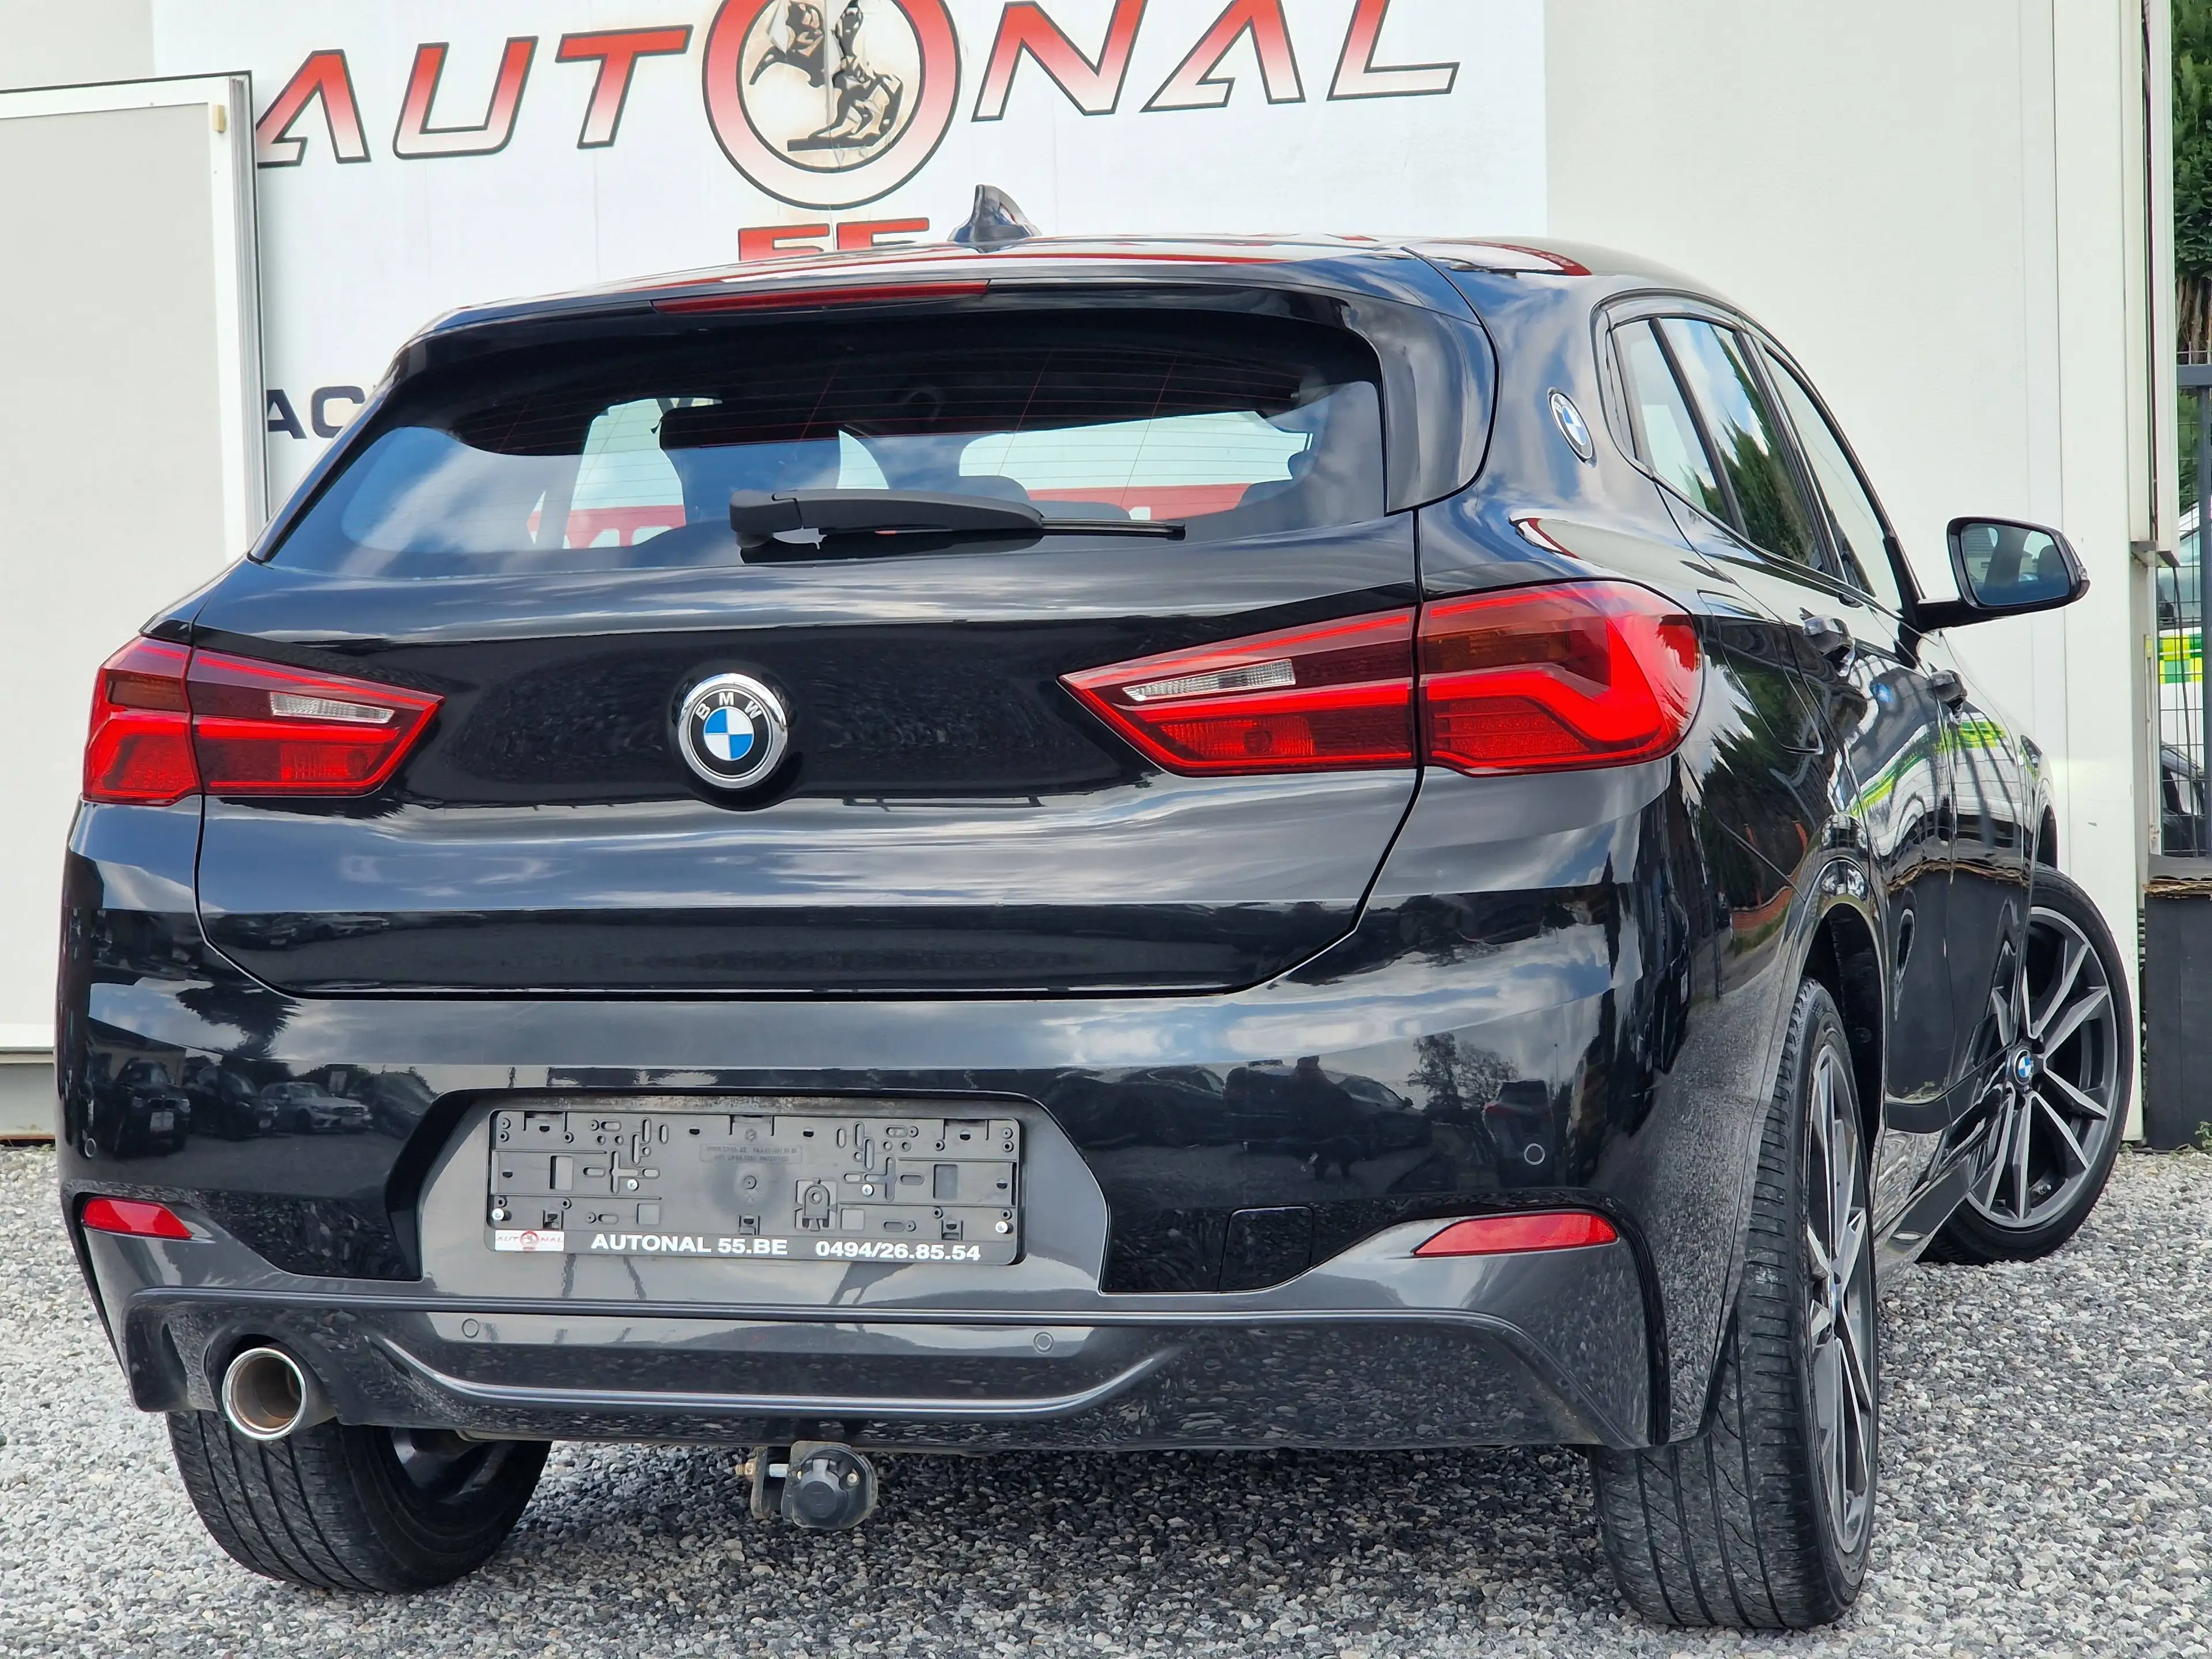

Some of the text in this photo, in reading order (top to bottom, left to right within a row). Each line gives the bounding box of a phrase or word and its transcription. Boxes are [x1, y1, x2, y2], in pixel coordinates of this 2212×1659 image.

[695, 692, 763, 721] BMW
[590, 1233, 981, 1260] AUTONAL 55.BE 0494/26.85.54
